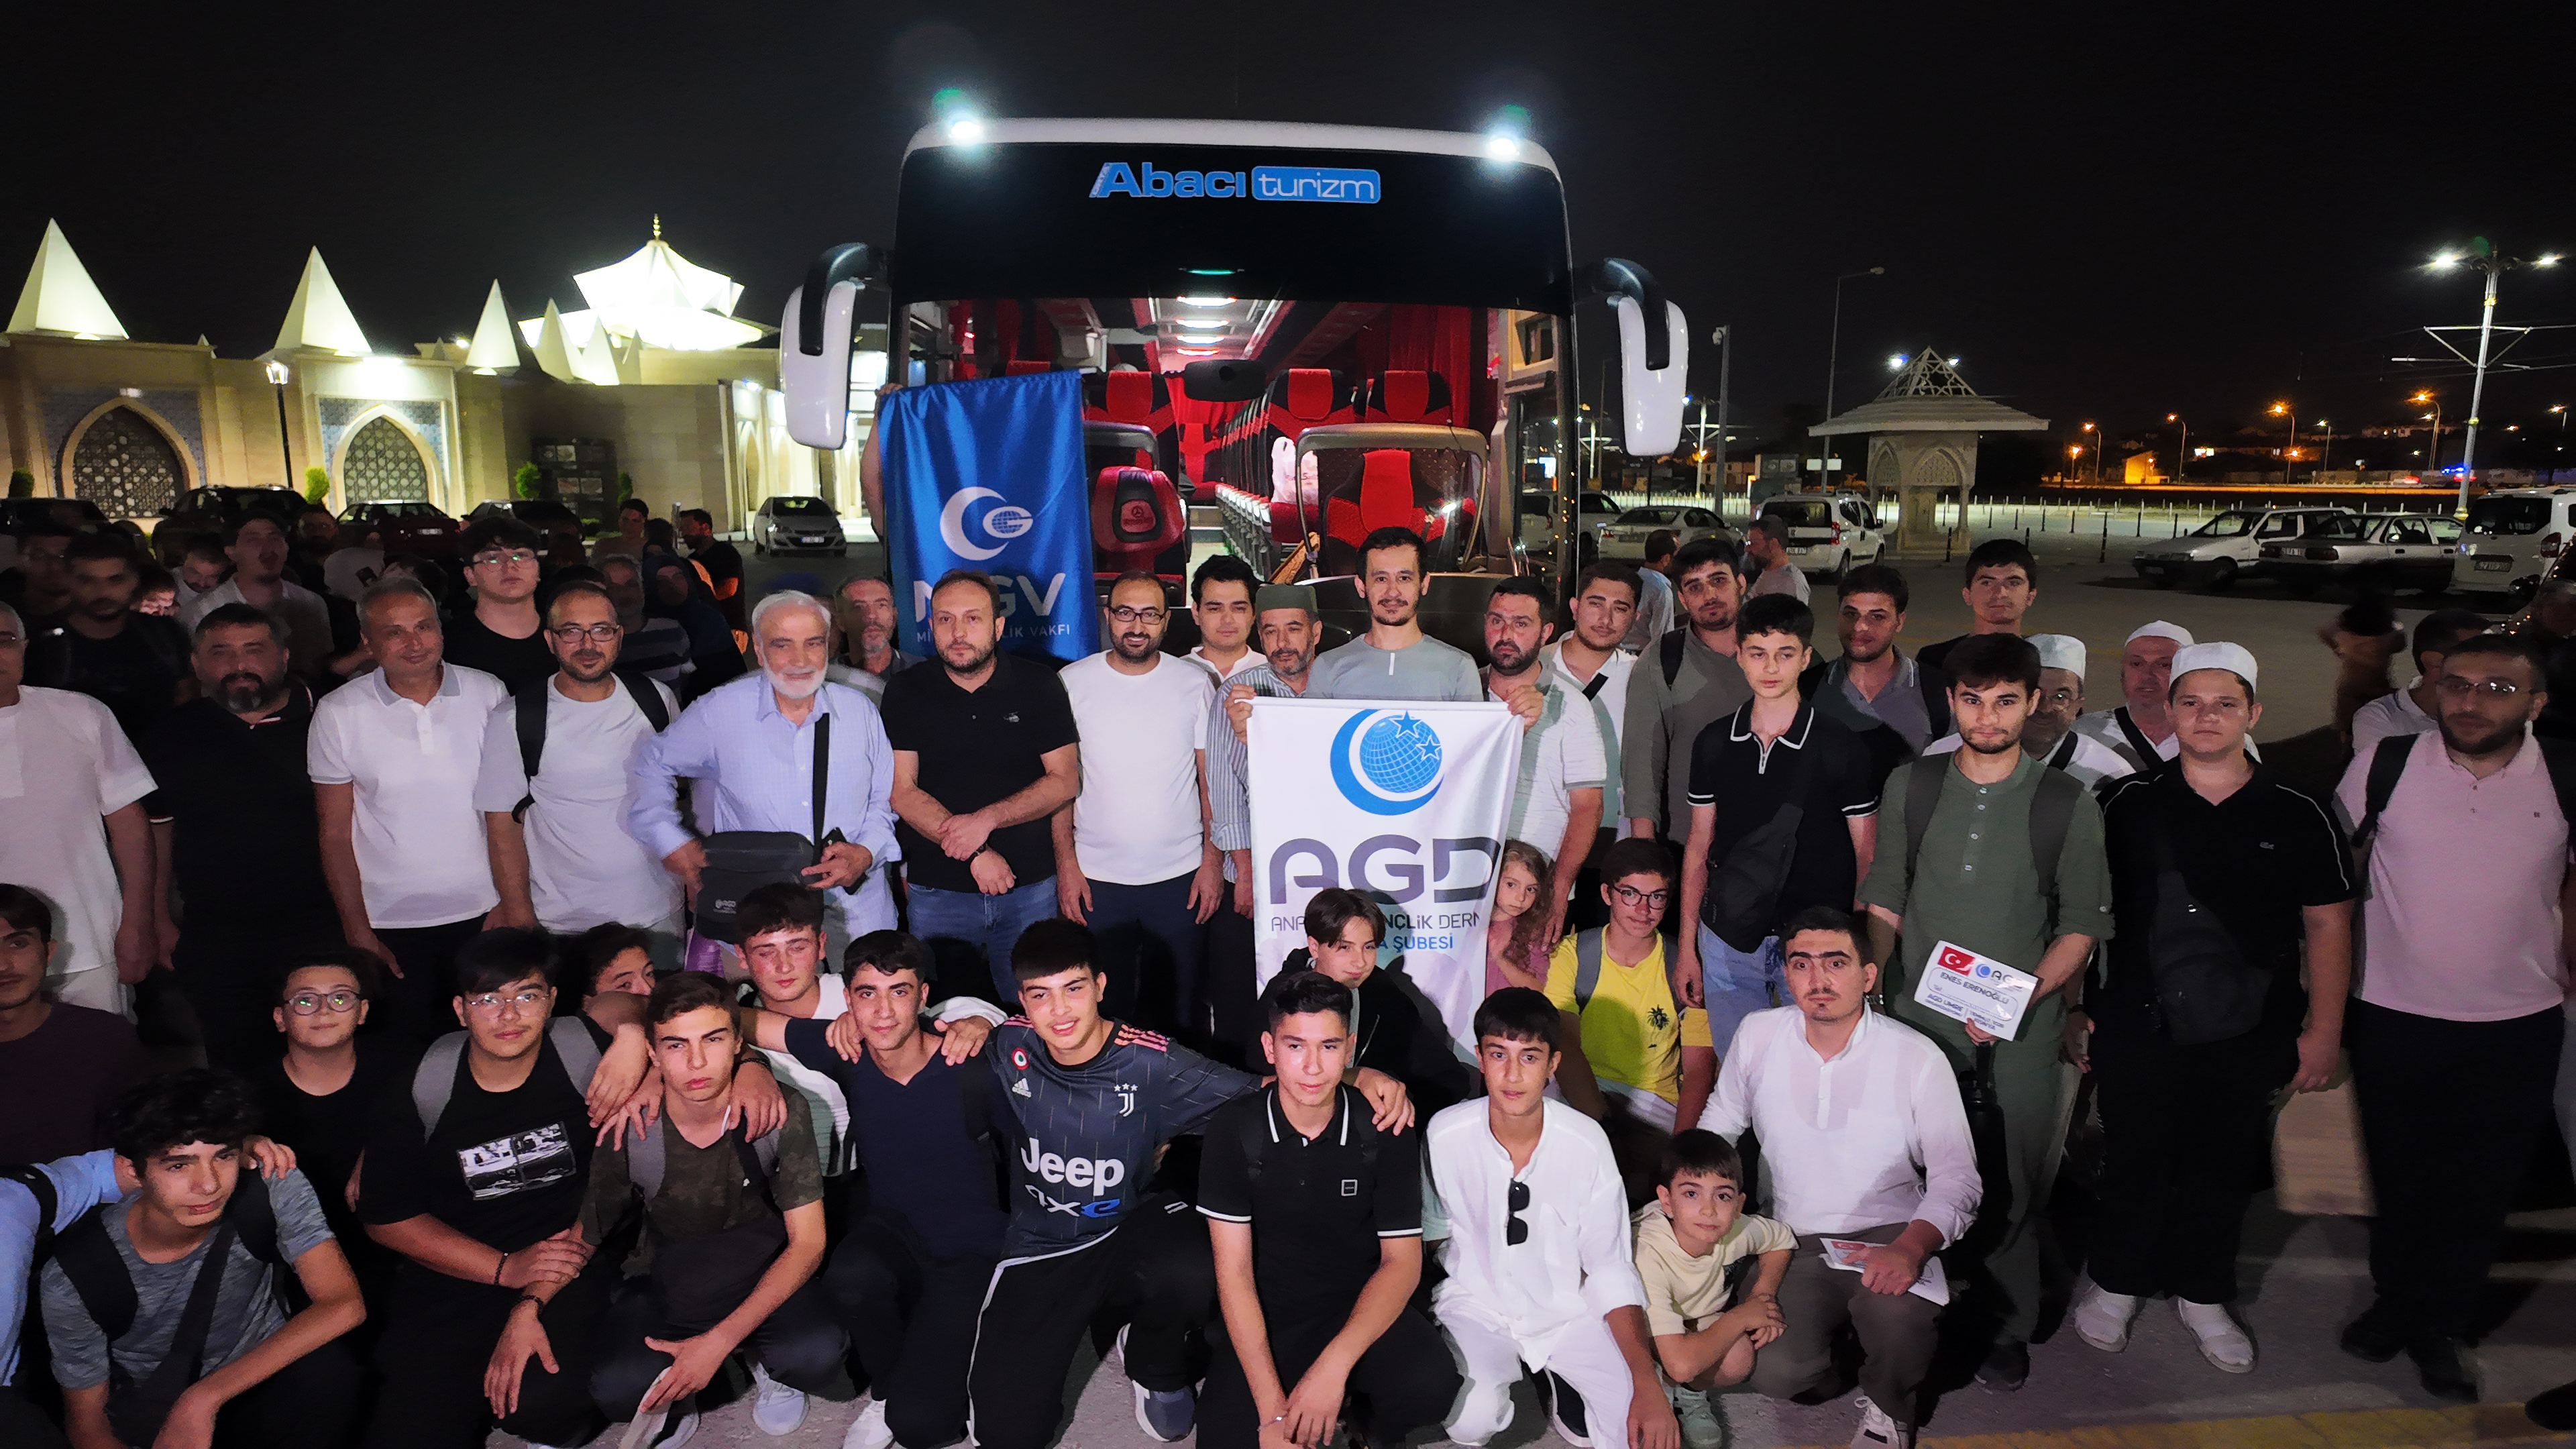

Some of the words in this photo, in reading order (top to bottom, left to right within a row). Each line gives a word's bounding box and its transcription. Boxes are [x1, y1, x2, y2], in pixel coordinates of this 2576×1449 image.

[1089, 162, 1246, 198] Abacı
[1258, 172, 1375, 199] turizm
[1030, 624, 1070, 637] VAKFI
[1269, 834, 1501, 904] AGD
[1393, 932, 1453, 953] ŞUBESİ
[1940, 972, 1962, 985] ENES
[1963, 981, 2009, 1004] ERENOĞLU
[1020, 1137, 1124, 1196] Jeep
